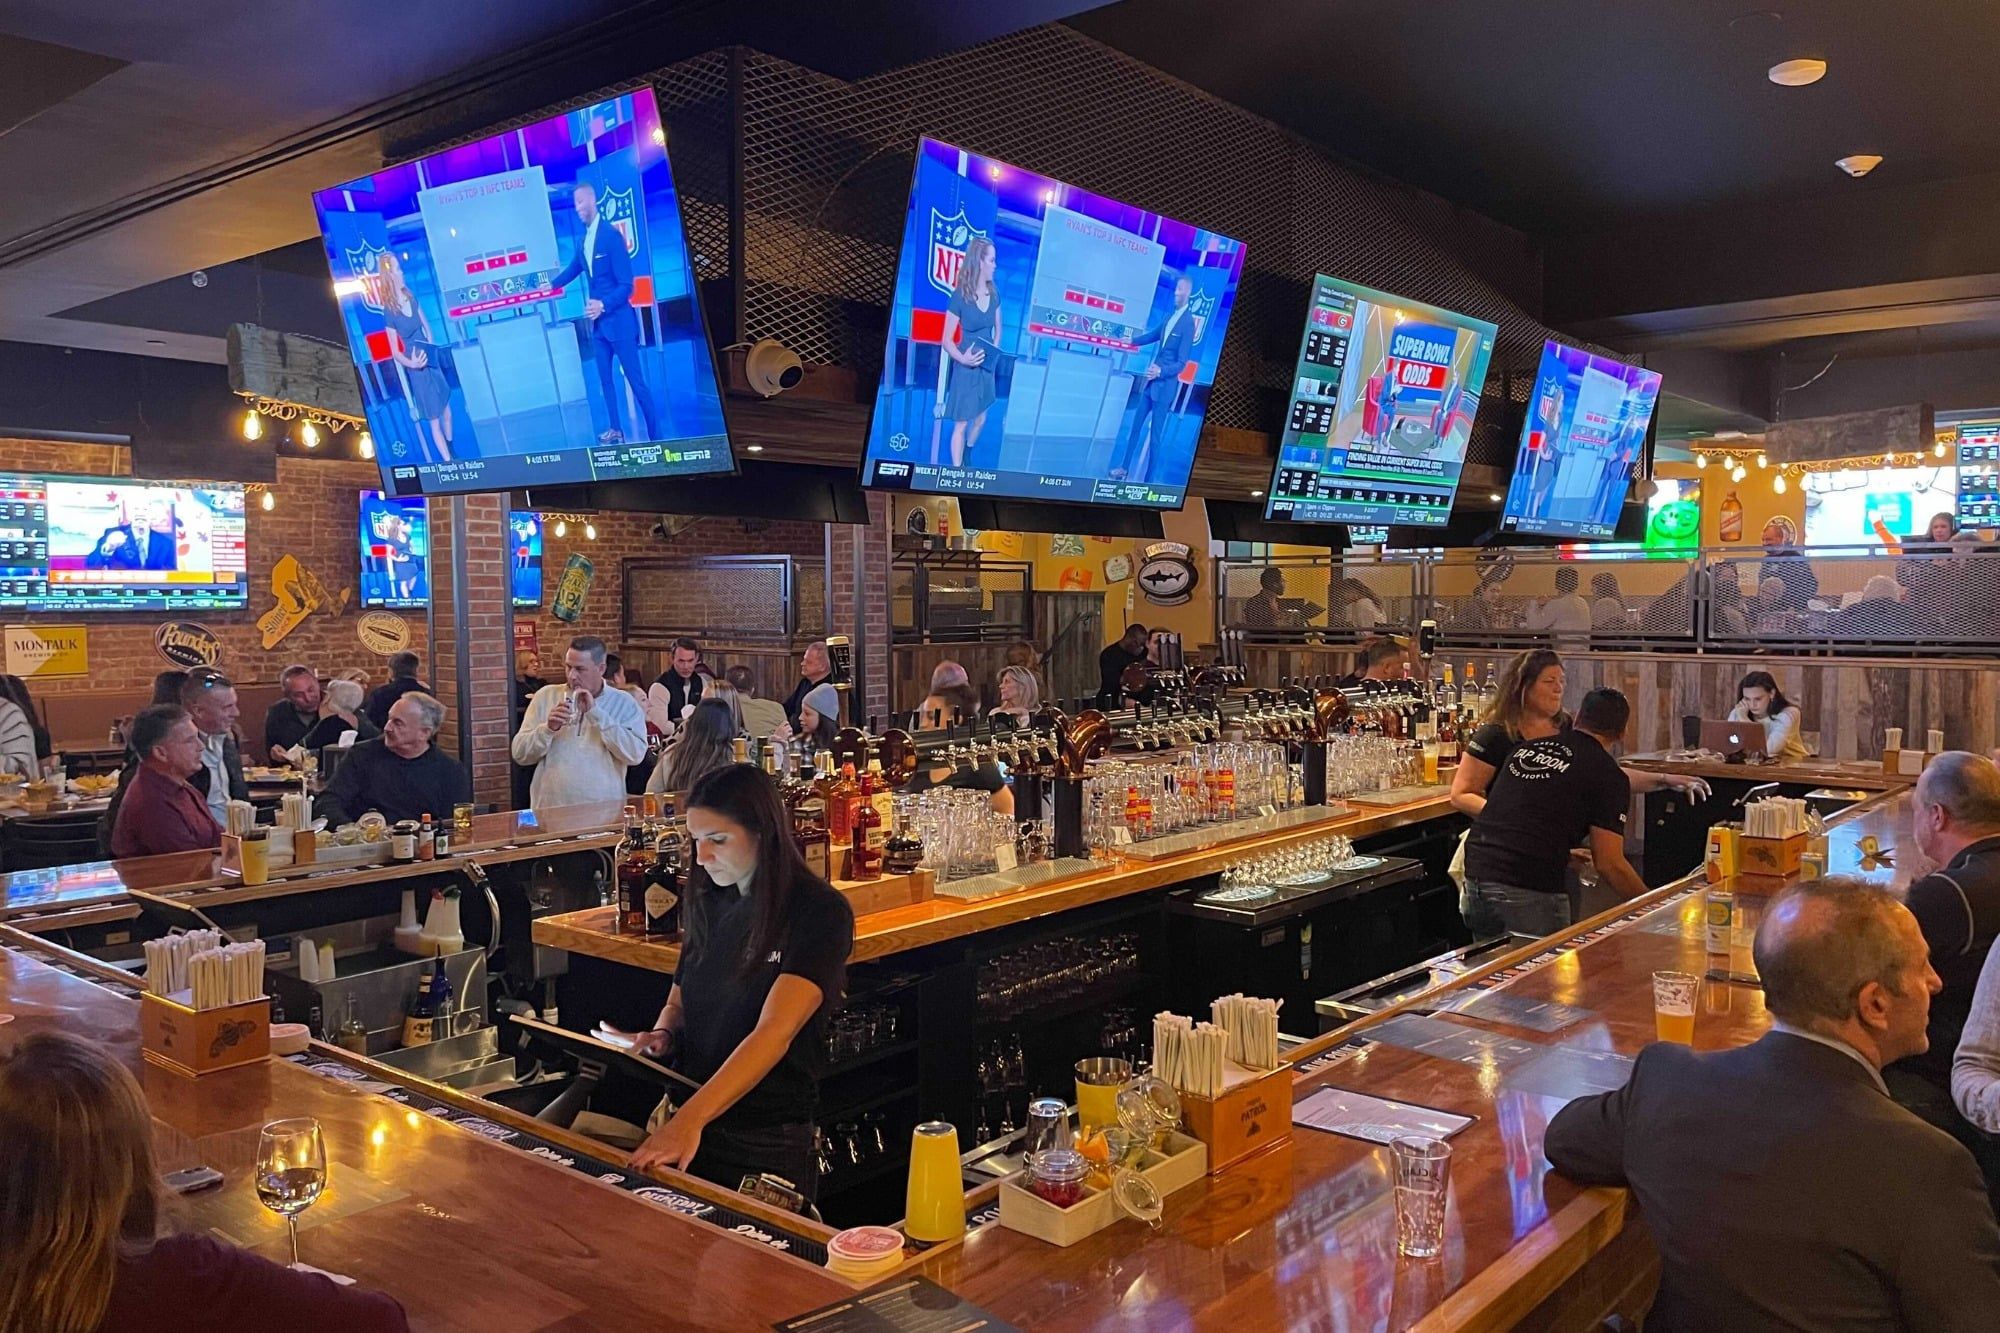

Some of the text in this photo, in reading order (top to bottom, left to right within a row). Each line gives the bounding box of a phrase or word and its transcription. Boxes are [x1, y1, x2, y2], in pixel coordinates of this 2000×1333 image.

[501, 178, 526, 191] TEAMS
[1393, 334, 1451, 364] SUPER BOWL
[1402, 363, 1433, 386] ODDS
[465, 461, 485, 470] Raiders
[878, 463, 909, 476] ESPN
[915, 466, 931, 474] WEEK
[394, 467, 416, 478] ESPN
[941, 468, 965, 478] Bengals
[975, 471, 997, 480] Raiders
[14, 639, 78, 651] MONTAUK
[160, 623, 220, 666] Founders
[1512, 748, 1570, 773] TAP ROOM
[1509, 762, 1551, 780] GOOD PEOPLE
